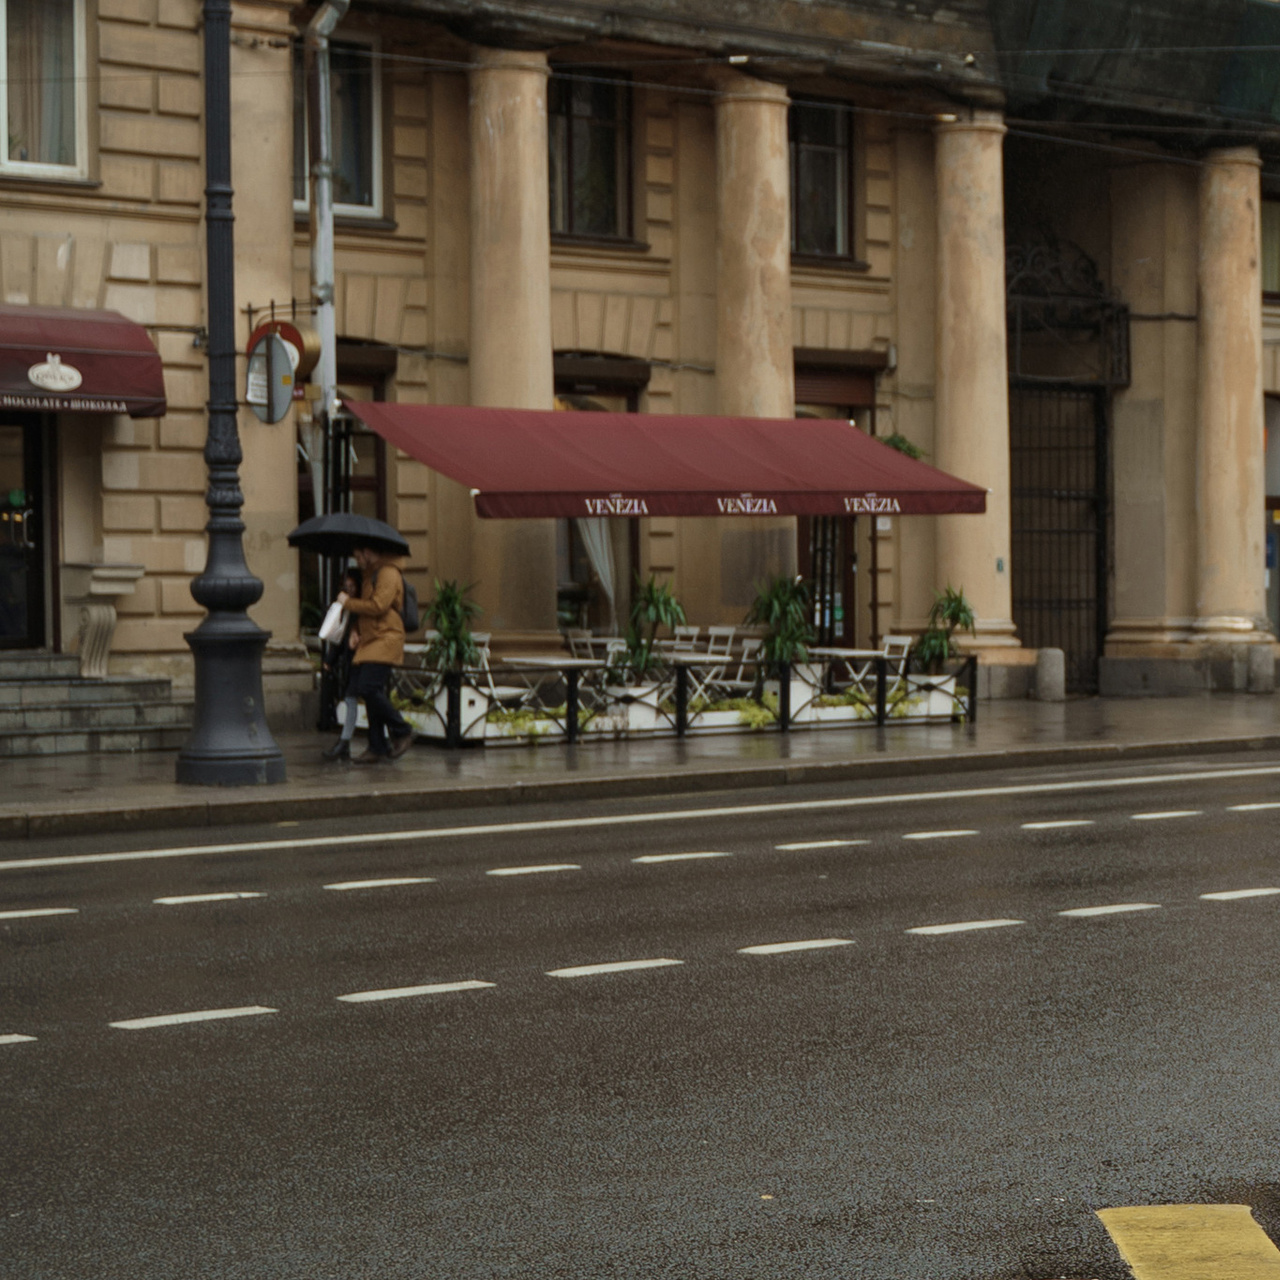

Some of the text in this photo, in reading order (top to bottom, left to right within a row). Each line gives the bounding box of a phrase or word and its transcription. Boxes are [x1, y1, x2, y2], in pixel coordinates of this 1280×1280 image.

[0, 395, 62, 409] HOCOLATE
[70, 399, 127, 412] ШОКОЛАД
[585, 498, 648, 514] VENEZIA
[717, 498, 777, 513] VENEZIA
[844, 497, 901, 513] VENEZIA
